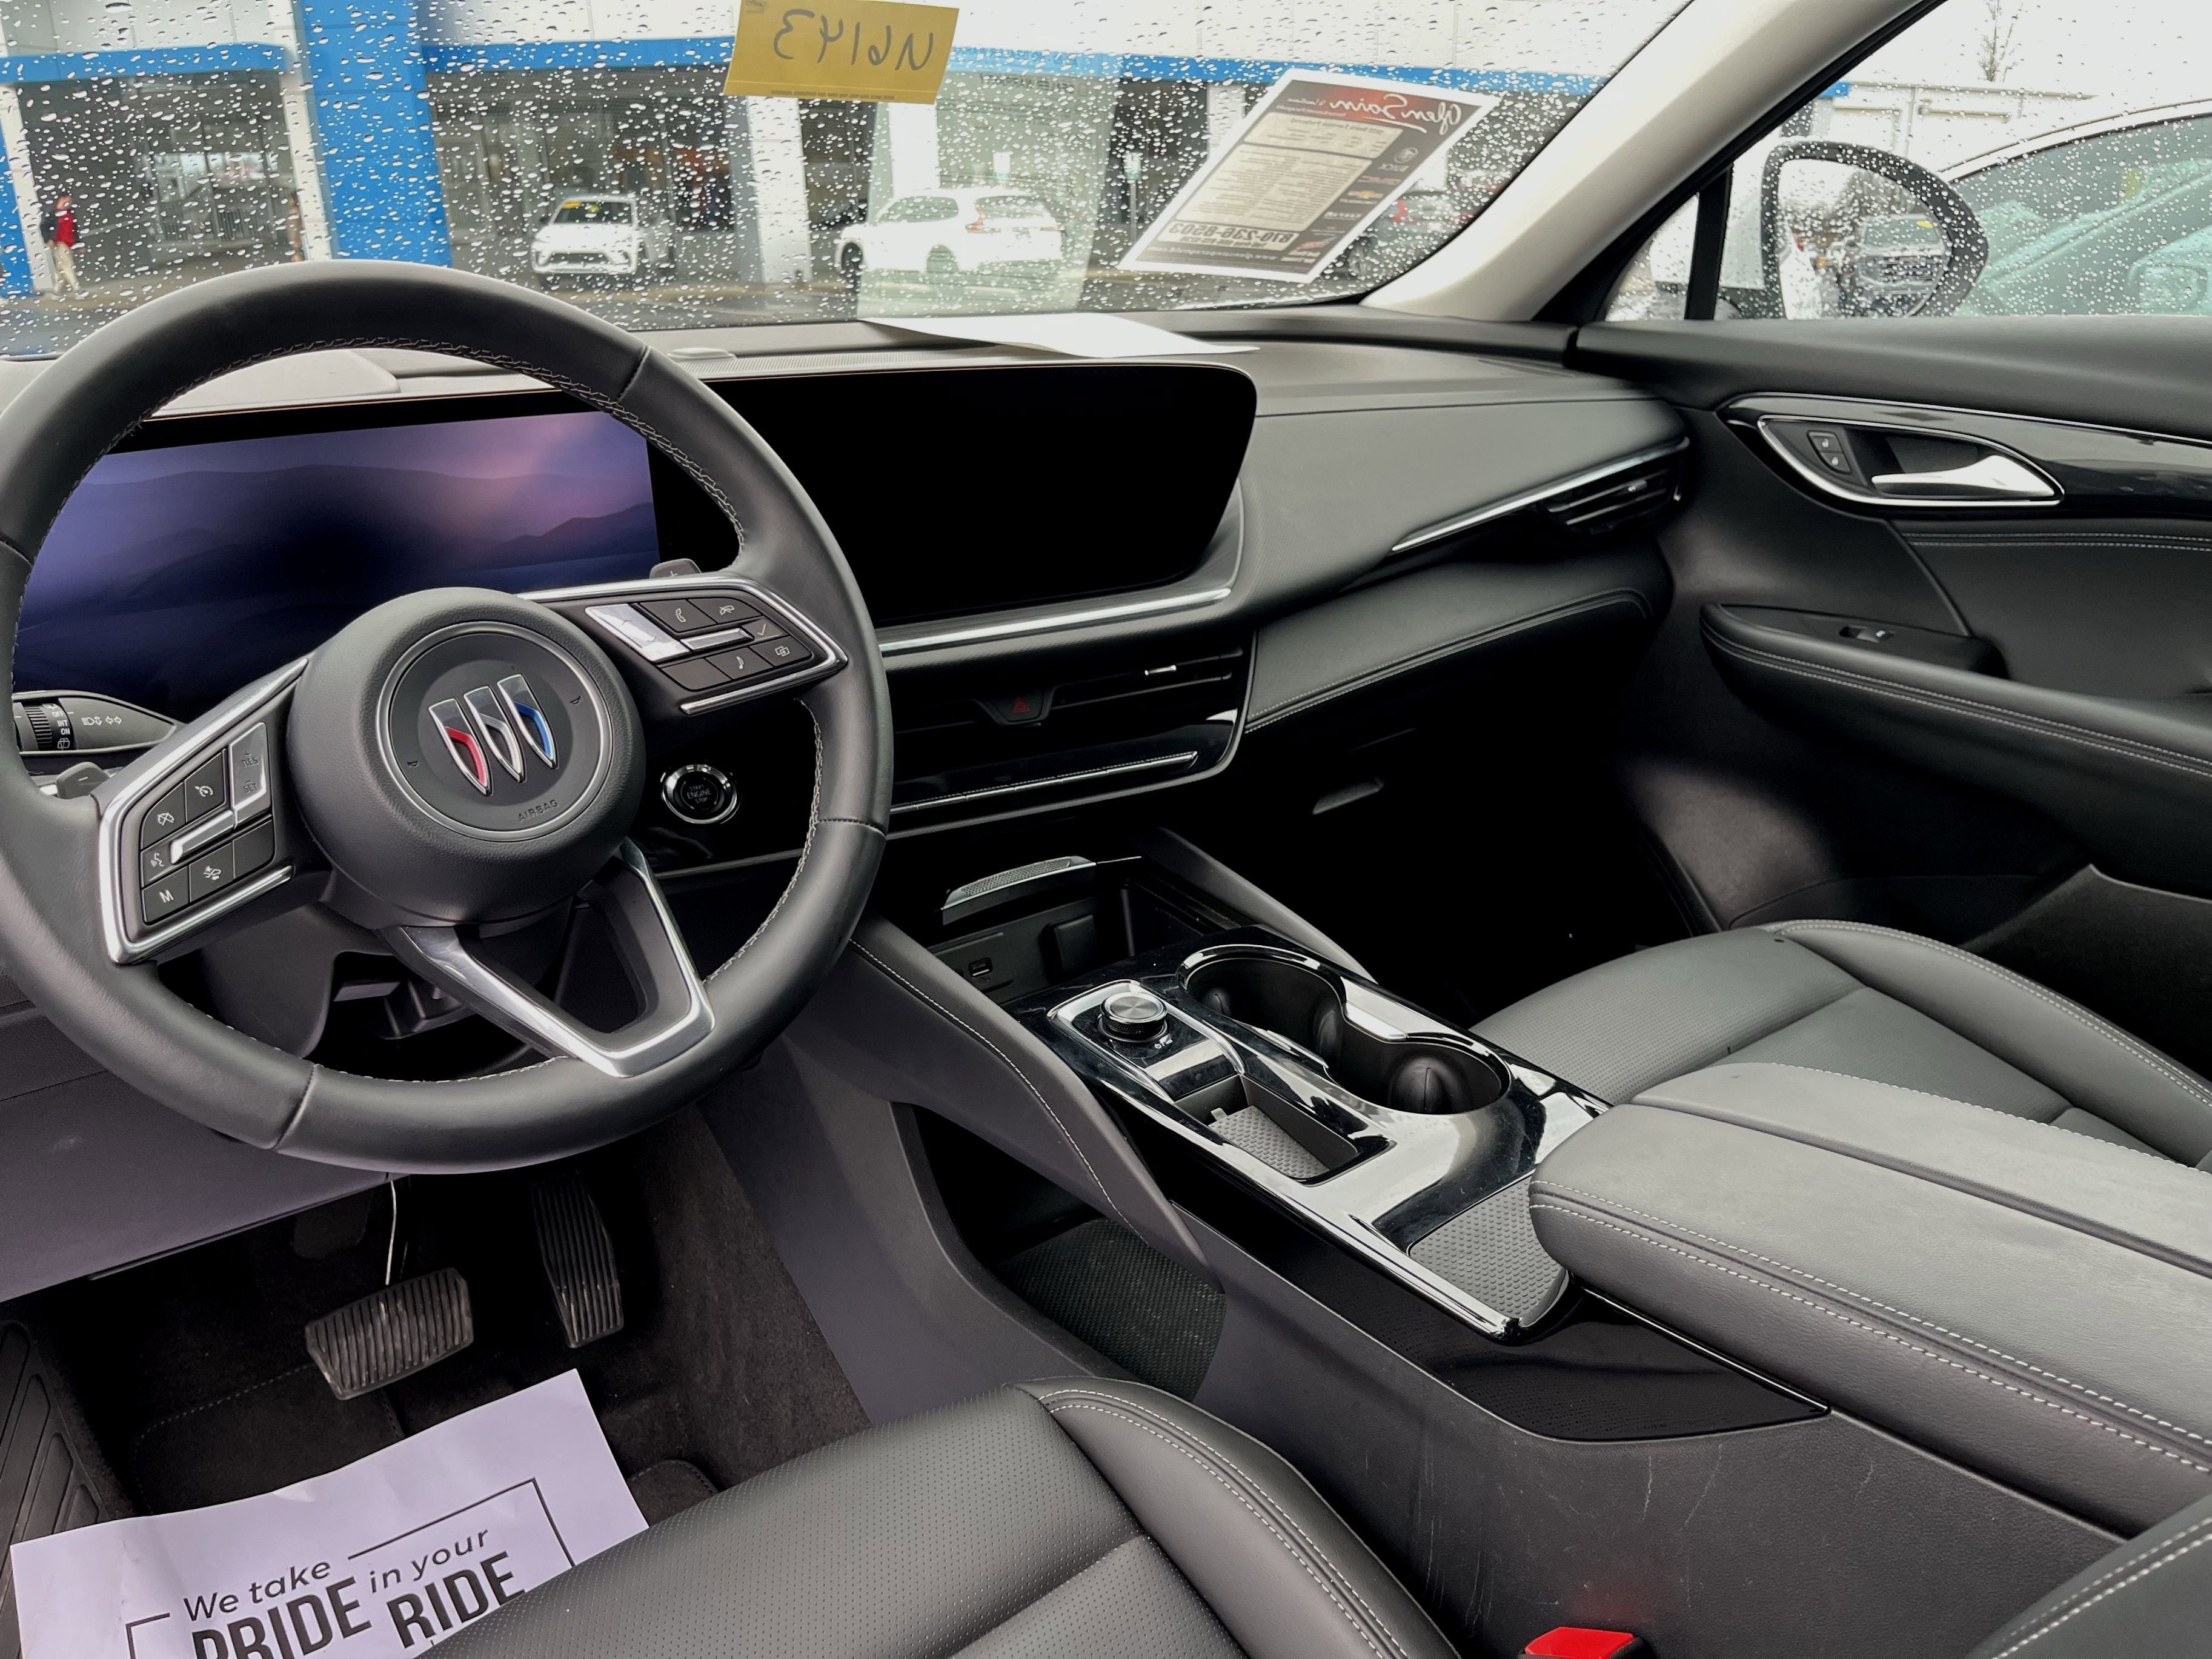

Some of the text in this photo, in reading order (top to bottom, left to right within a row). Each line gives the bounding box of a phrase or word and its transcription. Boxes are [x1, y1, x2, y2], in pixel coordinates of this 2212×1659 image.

[243, 782, 257, 793] SET
[686, 788, 712, 799] ENGINE
[519, 799, 559, 823] AIRBAG
[159, 889, 174, 903] M
[368, 1528, 489, 1594] in your
[183, 1560, 331, 1622] We take
[386, 1551, 525, 1643] RIDE
